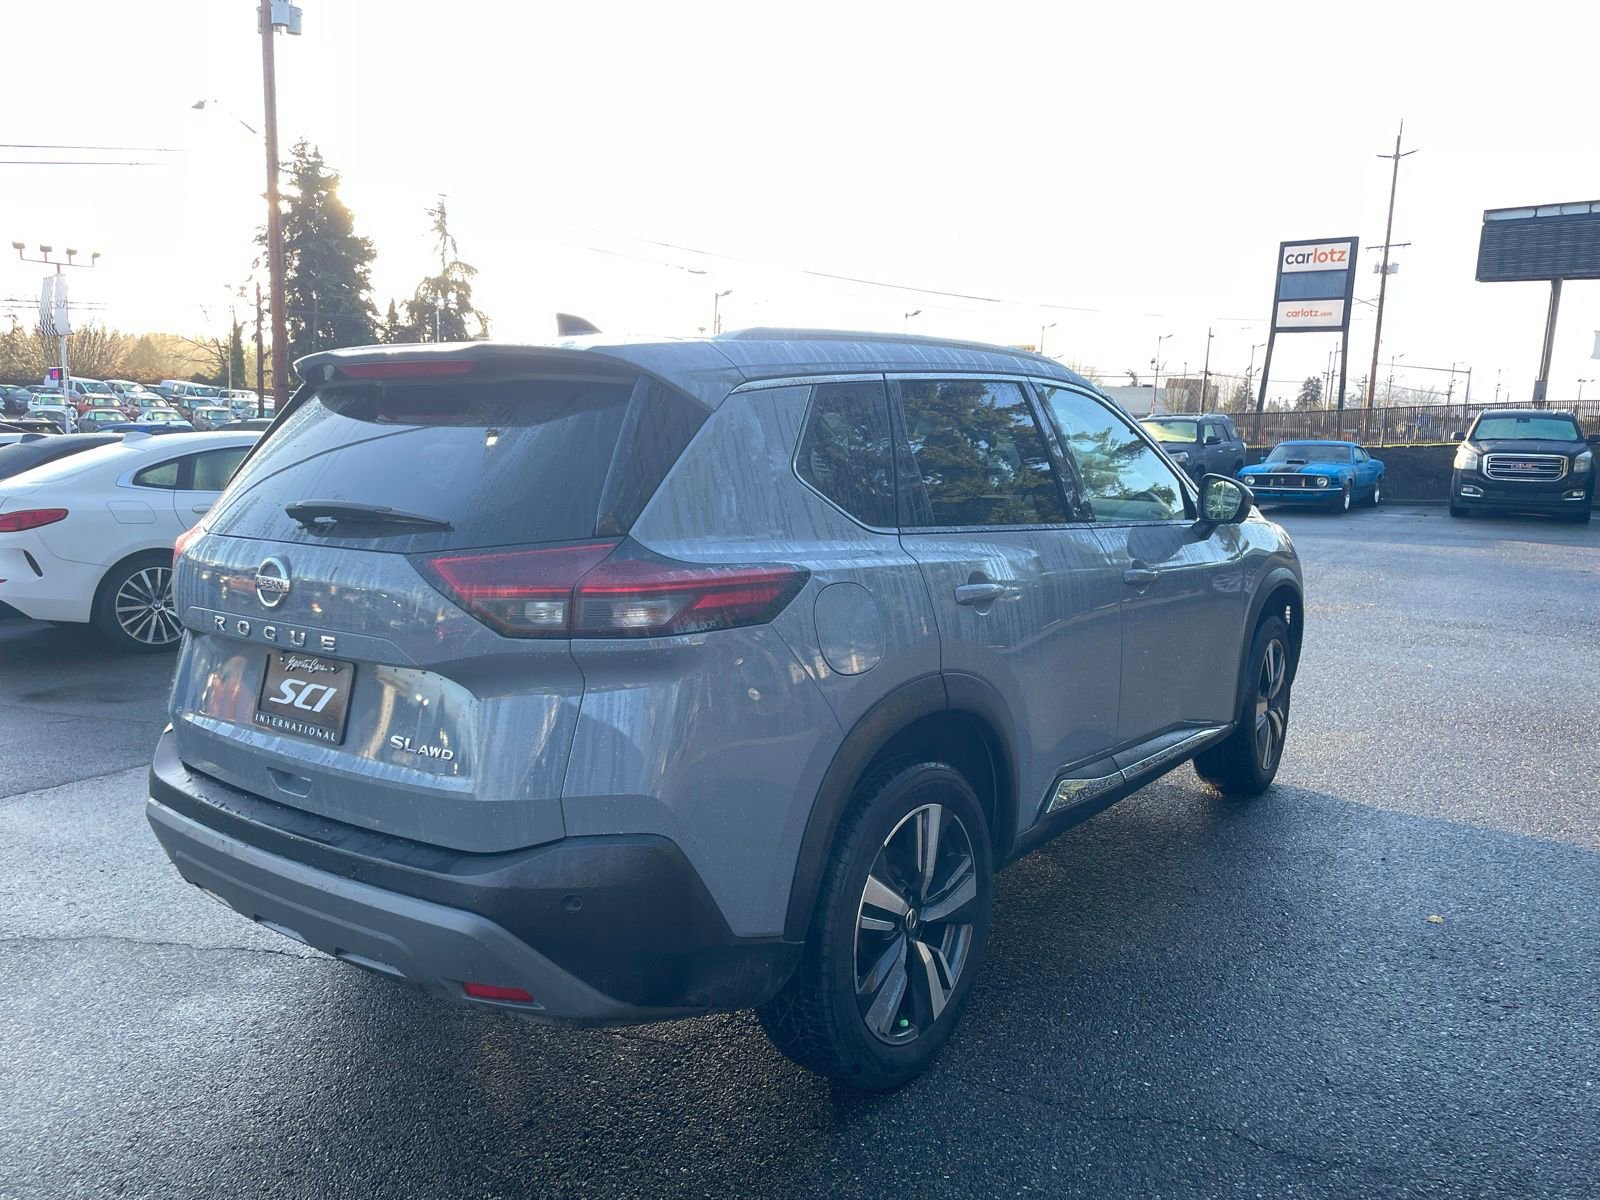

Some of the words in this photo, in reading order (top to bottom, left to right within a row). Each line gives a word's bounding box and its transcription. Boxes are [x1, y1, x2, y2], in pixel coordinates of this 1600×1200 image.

[1285, 247, 1347, 265] carlotz
[1286, 309, 1333, 318] carlotz.com
[214, 615, 336, 651] ROGUE
[268, 678, 338, 712] SCI
[255, 713, 336, 741] INTERNATIONAL
[390, 735, 418, 754] SL
[418, 744, 454, 760] AWD
